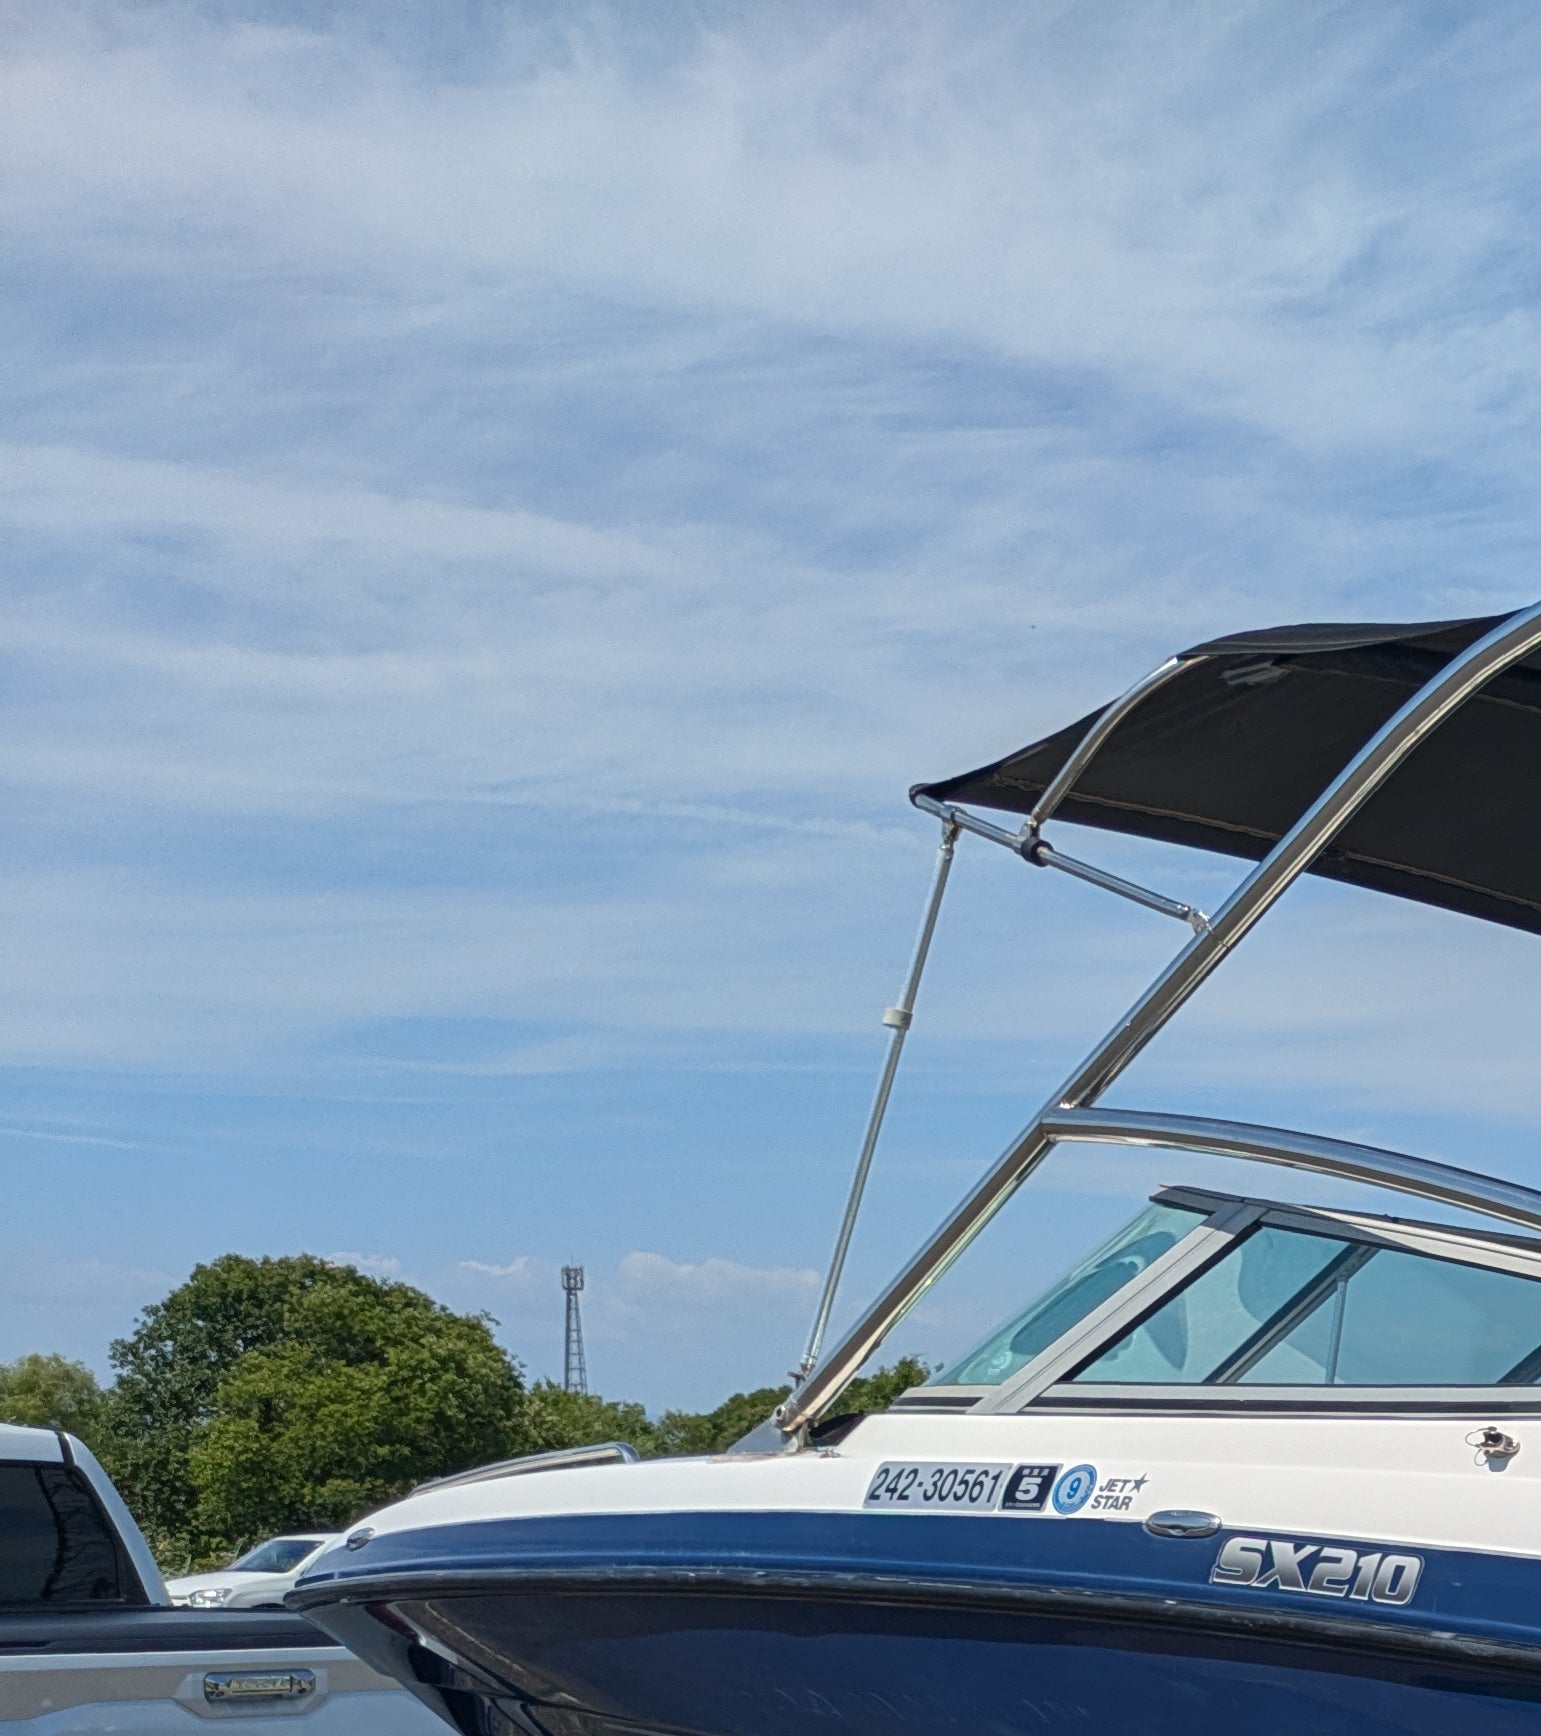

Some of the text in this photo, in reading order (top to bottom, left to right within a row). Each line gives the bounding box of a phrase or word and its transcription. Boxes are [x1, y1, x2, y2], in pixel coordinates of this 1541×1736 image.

[867, 1467, 1004, 1504] 242-30561
[1014, 1476, 1043, 1501] 5
[1066, 1476, 1082, 1500] 9
[1098, 1477, 1134, 1494] JET
[1090, 1494, 1134, 1511] STAR
[1211, 1535, 1424, 1606] SX210
